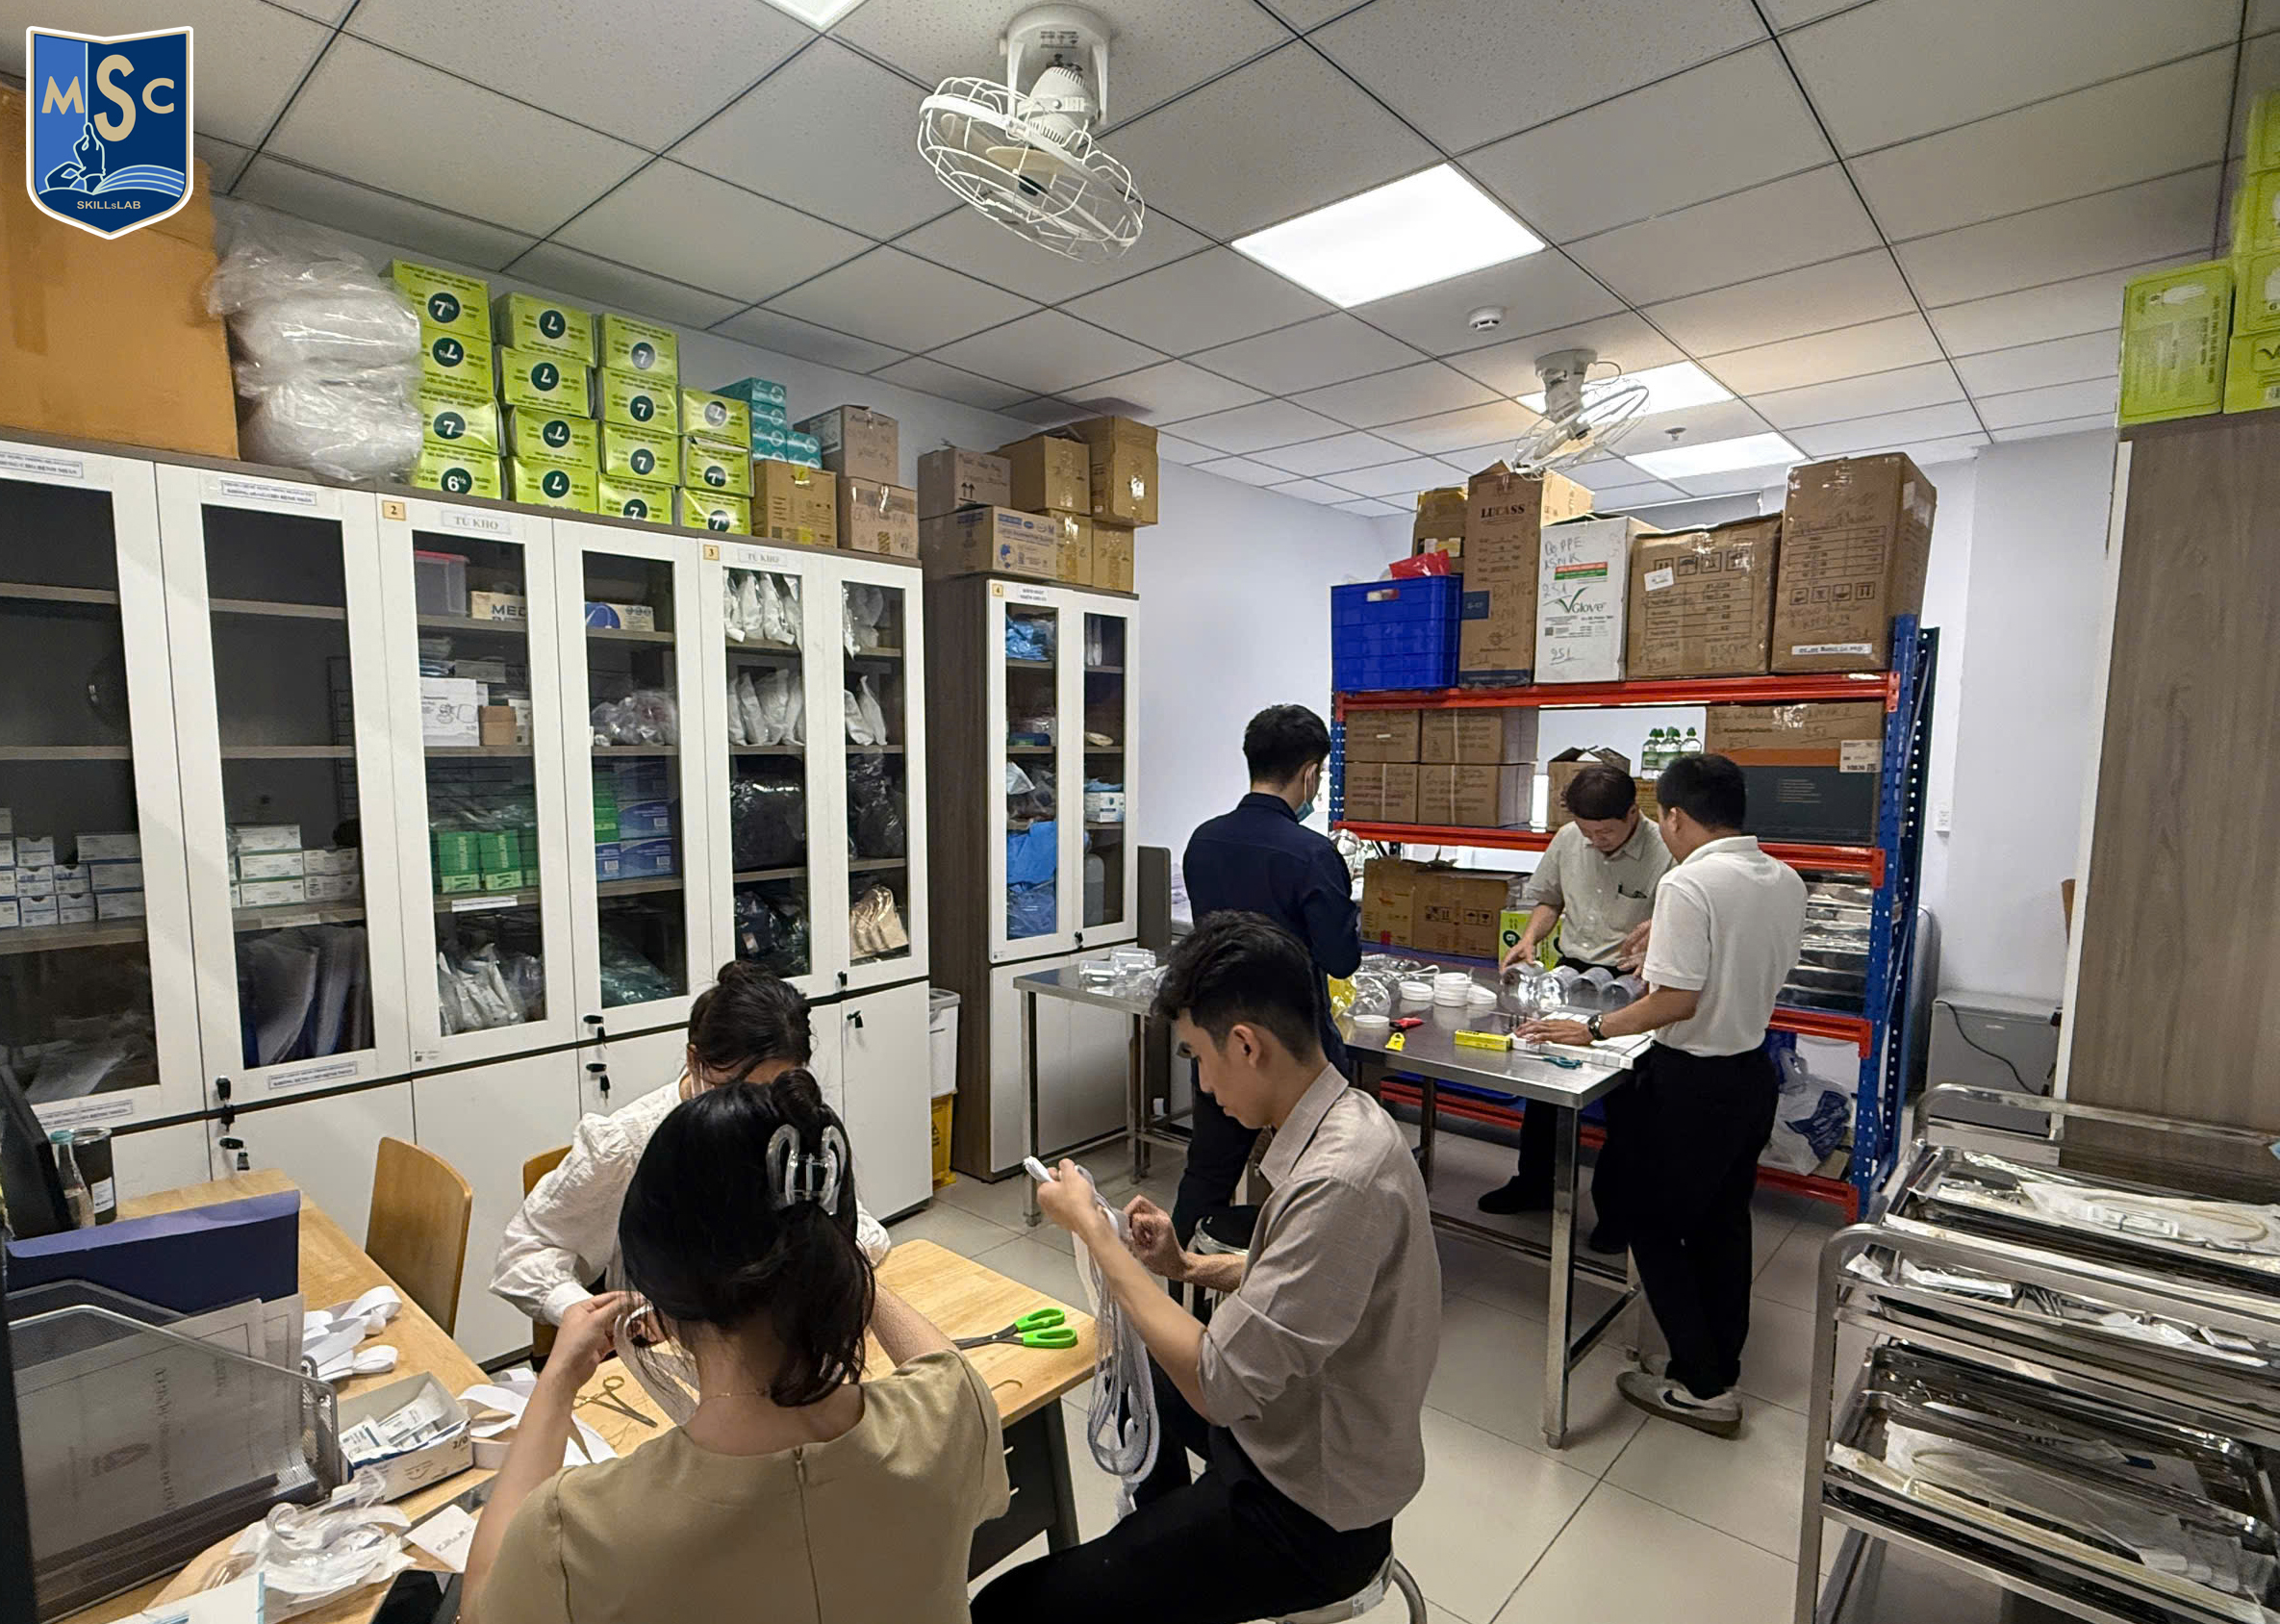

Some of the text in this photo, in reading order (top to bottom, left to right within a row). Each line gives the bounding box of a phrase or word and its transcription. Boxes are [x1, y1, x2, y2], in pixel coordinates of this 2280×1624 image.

[547, 315, 559, 332] 7
[638, 348, 649, 365] 7
[541, 368, 552, 384] 7
[636, 402, 647, 419] 7
[443, 419, 457, 436] 7
[636, 455, 647, 470] 7
[551, 474, 563, 491] 7
[391, 505, 397, 515] 2
[629, 505, 642, 520] 7
[1481, 503, 1525, 519] LUCASS
[708, 547, 715, 557] 3
